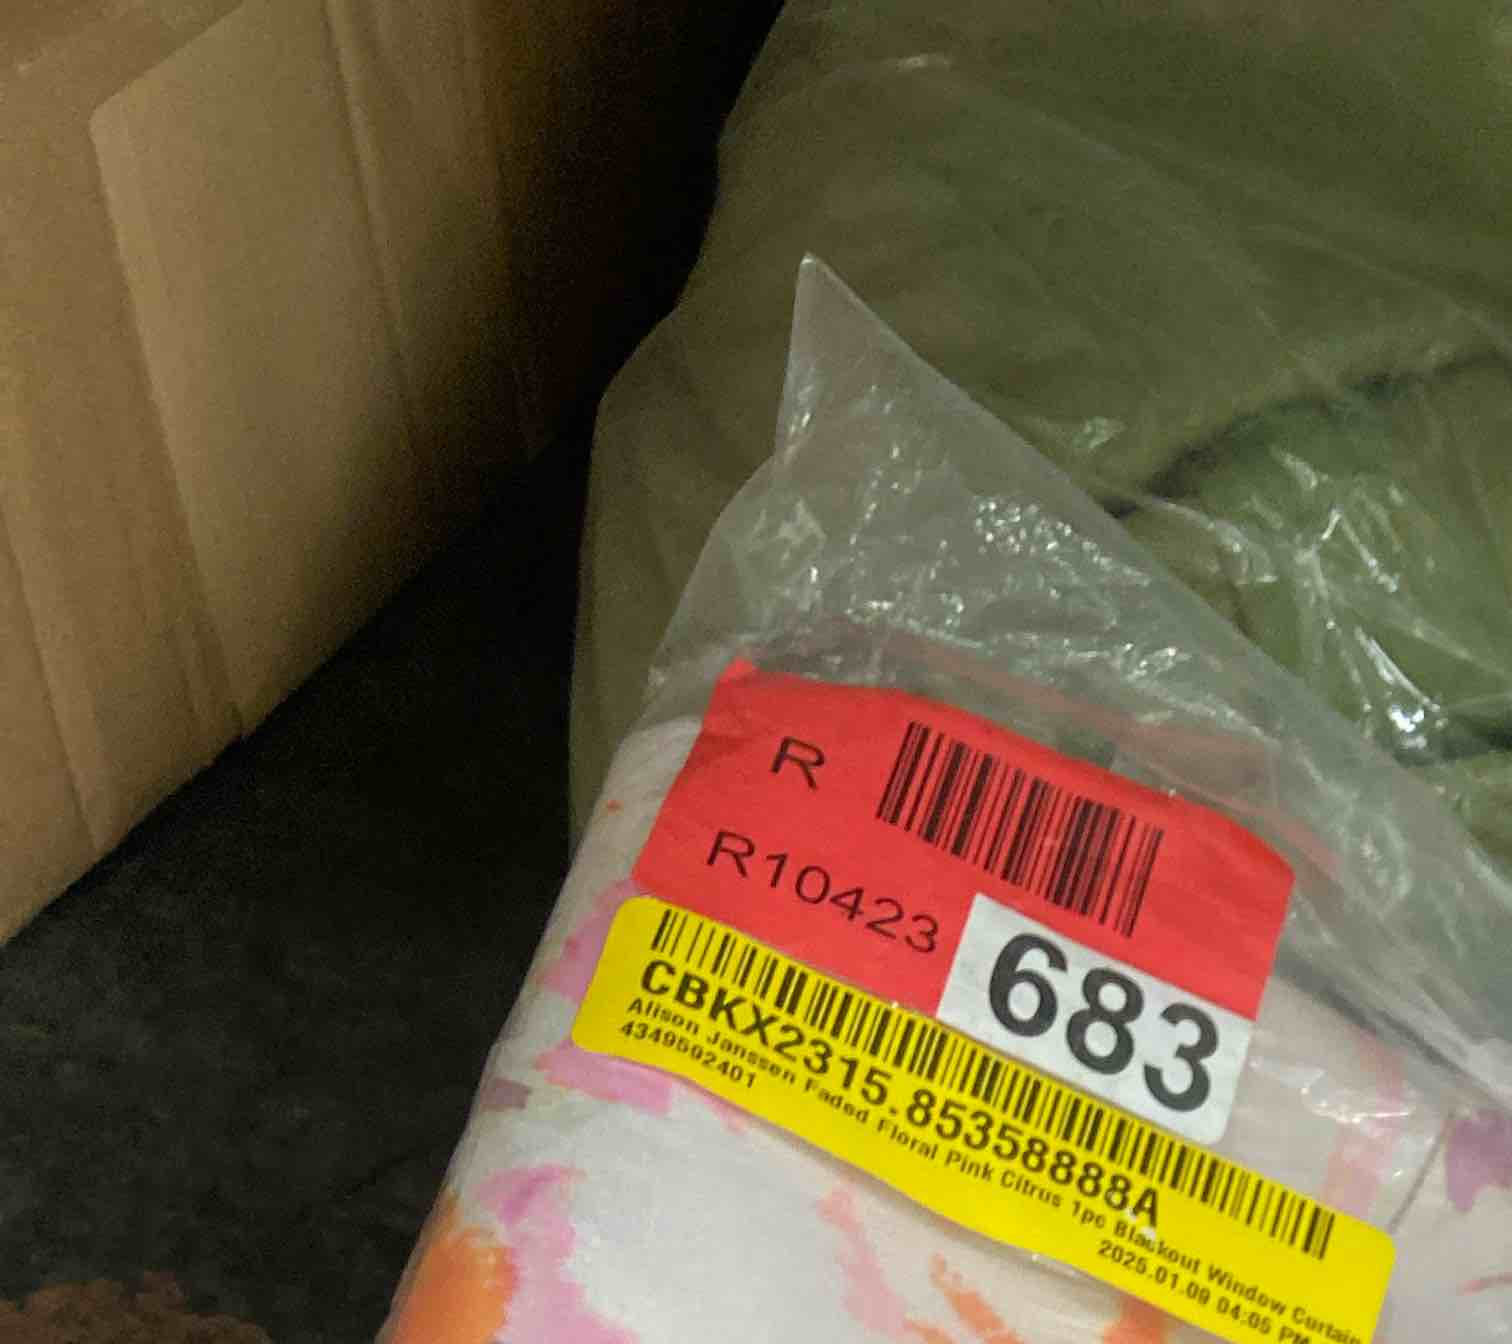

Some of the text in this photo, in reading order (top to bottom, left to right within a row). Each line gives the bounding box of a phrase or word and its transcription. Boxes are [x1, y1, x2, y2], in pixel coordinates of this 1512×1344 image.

[771, 736, 825, 790] R
[707, 831, 939, 953] R10423
[640, 959, 1159, 1228] CBKX2315.85358888A
[989, 933, 1220, 1113] 683
[627, 997, 699, 1035] Alison
[707, 1029, 796, 1084] Janssen
[804, 1078, 870, 1124] Faded
[877, 1118, 938, 1160] Floral
[945, 1150, 994, 1182] Pink
[1001, 1167, 1061, 1207] Citrus
[1072, 1201, 1105, 1229] 1pc
[1114, 1220, 1201, 1273] Blackout
[1207, 1264, 1285, 1317] Window
